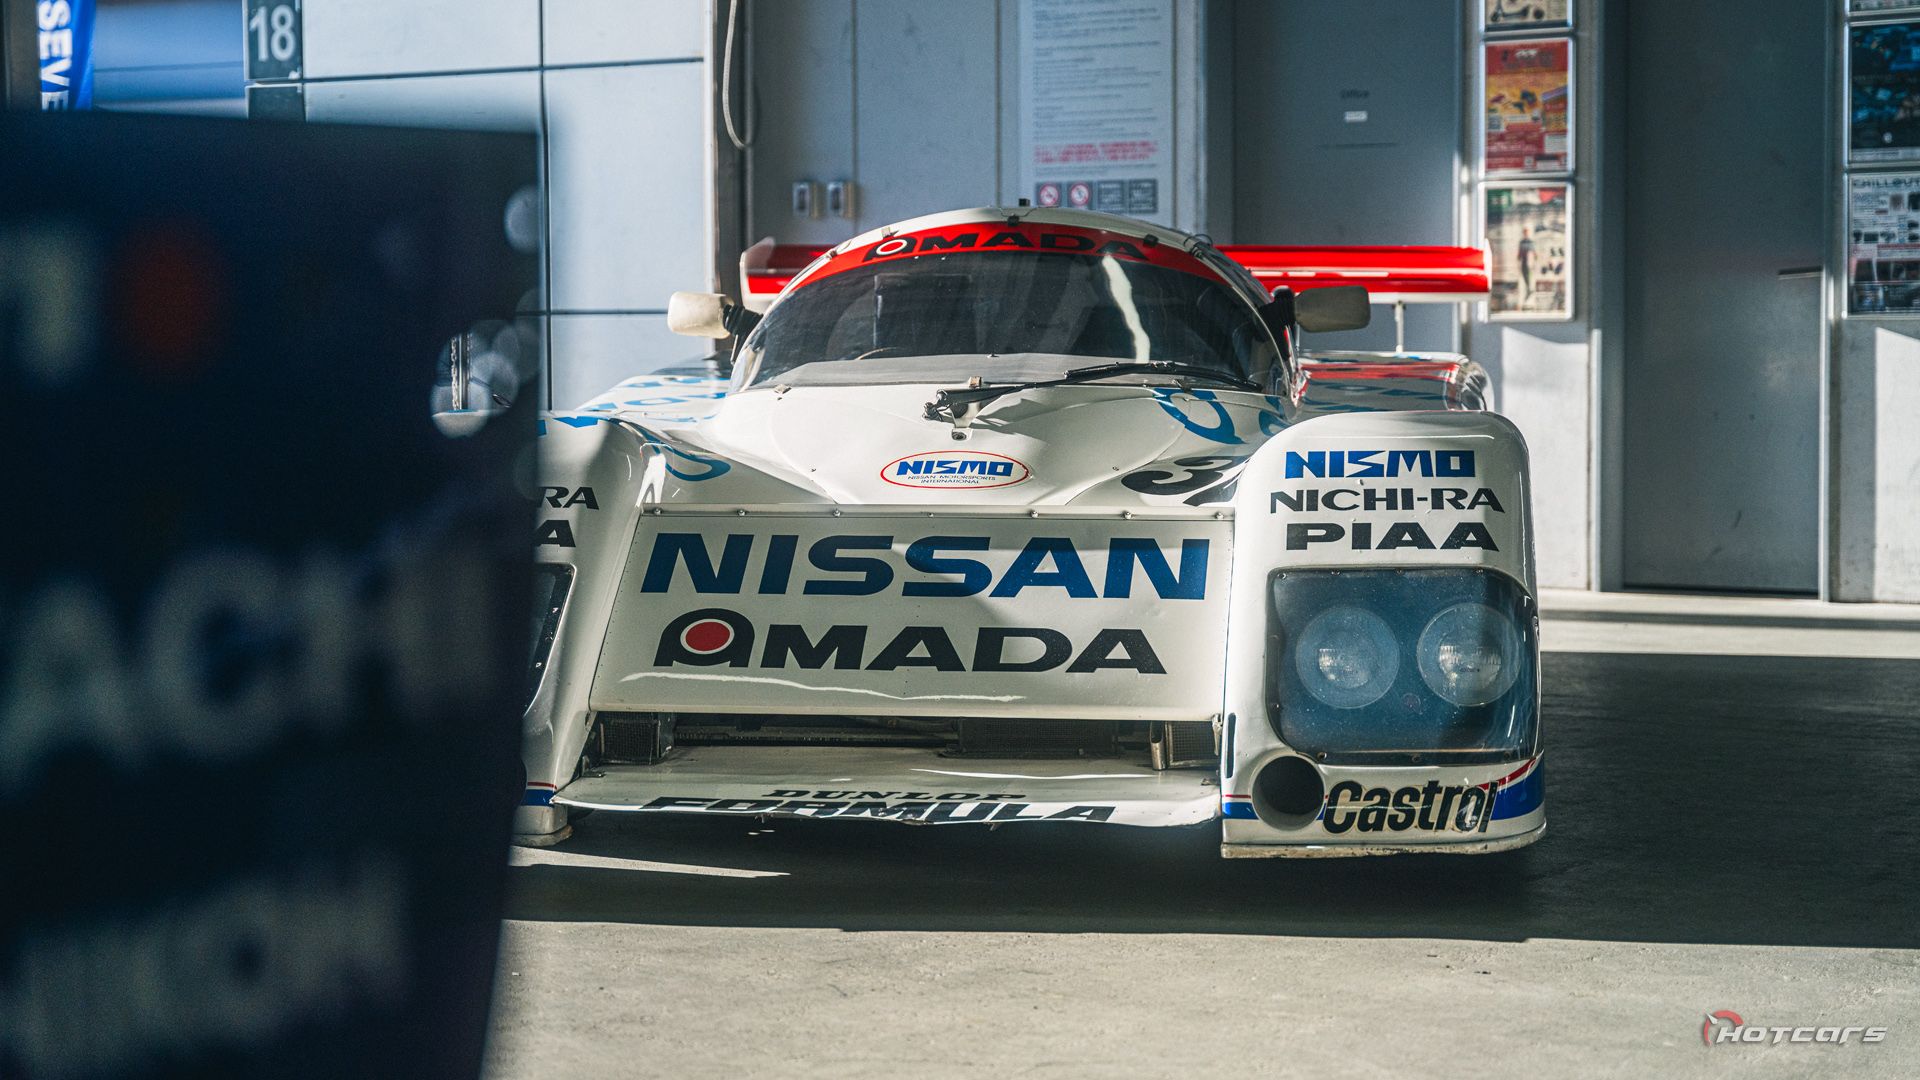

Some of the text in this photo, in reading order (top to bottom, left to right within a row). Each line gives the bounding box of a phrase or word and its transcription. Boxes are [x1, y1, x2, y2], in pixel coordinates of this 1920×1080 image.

[249, 4, 296, 61] 18
[862, 231, 1150, 262] AMADA
[896, 460, 1014, 477] NISMO
[1284, 450, 1475, 479] NISMO
[1270, 487, 1505, 514] NICHI-RA
[1286, 521, 1500, 551] PIAA
[639, 532, 1210, 600] NISSAN
[653, 608, 1168, 675] AMADA
[639, 796, 1117, 823] FORMULA
[762, 789, 1027, 801] DUNLOP
[1322, 779, 1499, 835] Castrol
